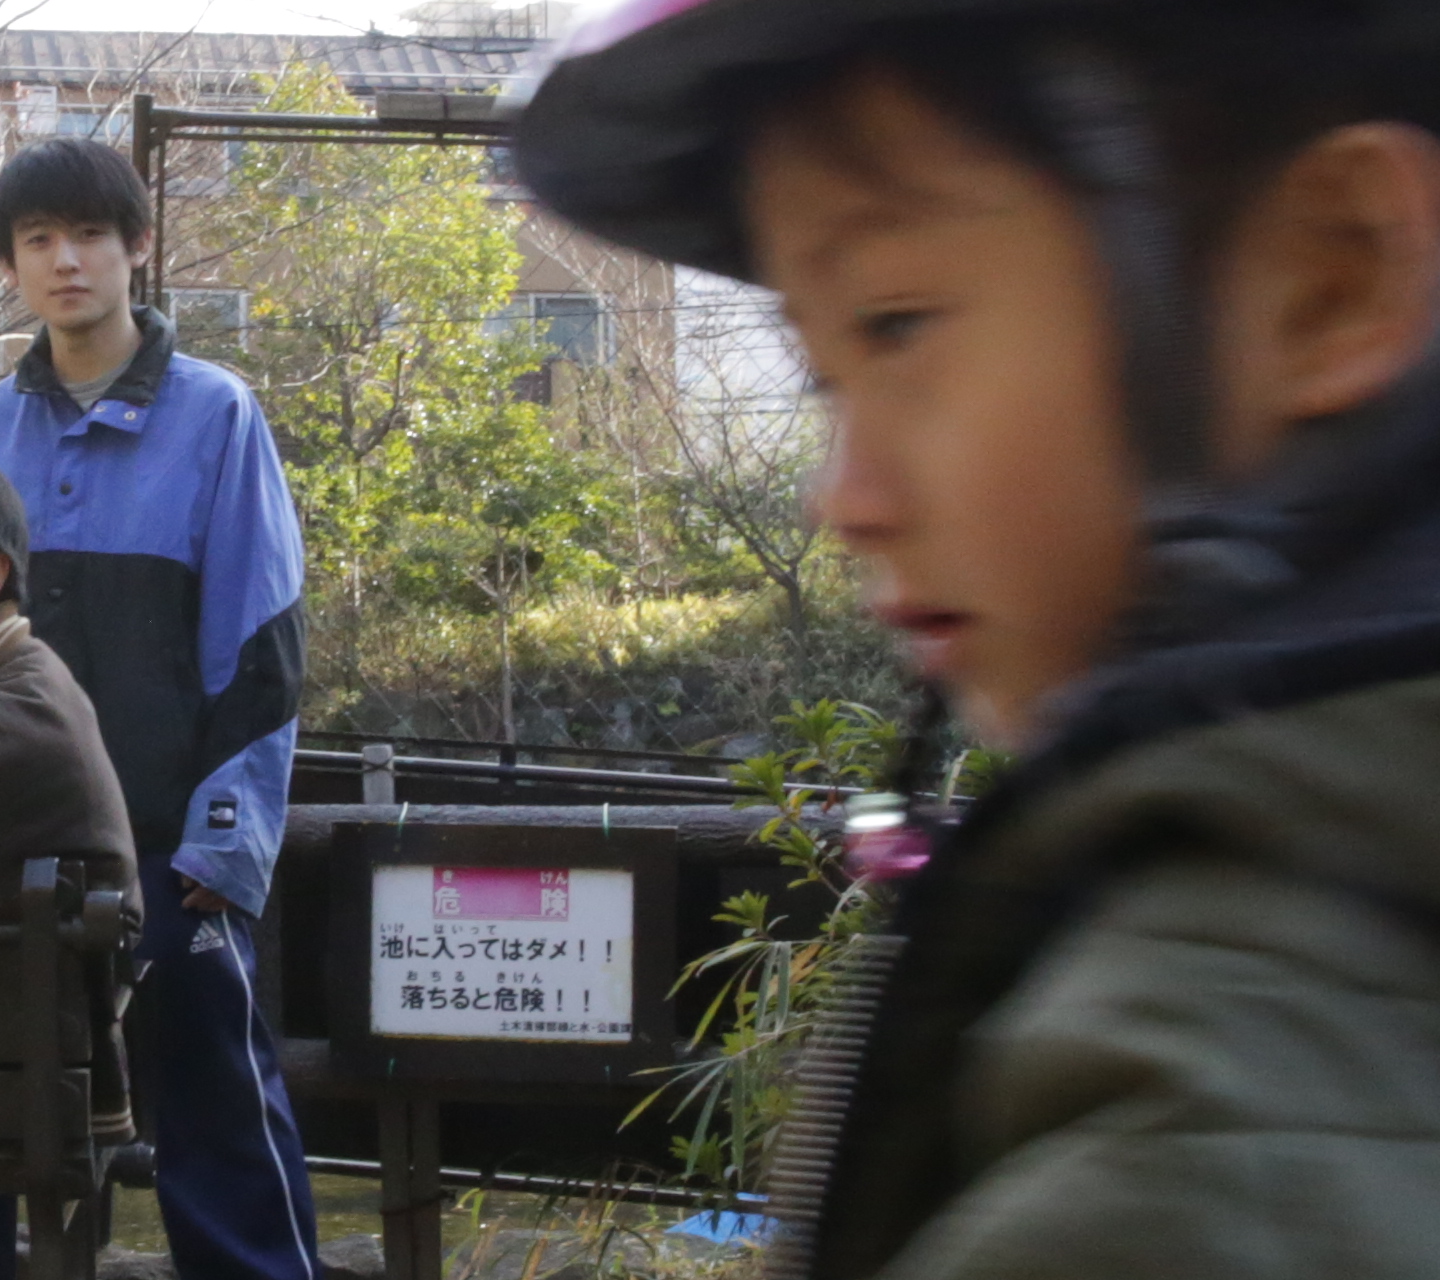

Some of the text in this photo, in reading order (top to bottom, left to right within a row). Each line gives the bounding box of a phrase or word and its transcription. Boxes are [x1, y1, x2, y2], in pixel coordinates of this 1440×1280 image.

[435, 886, 568, 917] 危険
[380, 935, 613, 963] 池に入ってはダメ！！
[400, 985, 590, 1013] 落ちると危険！！
